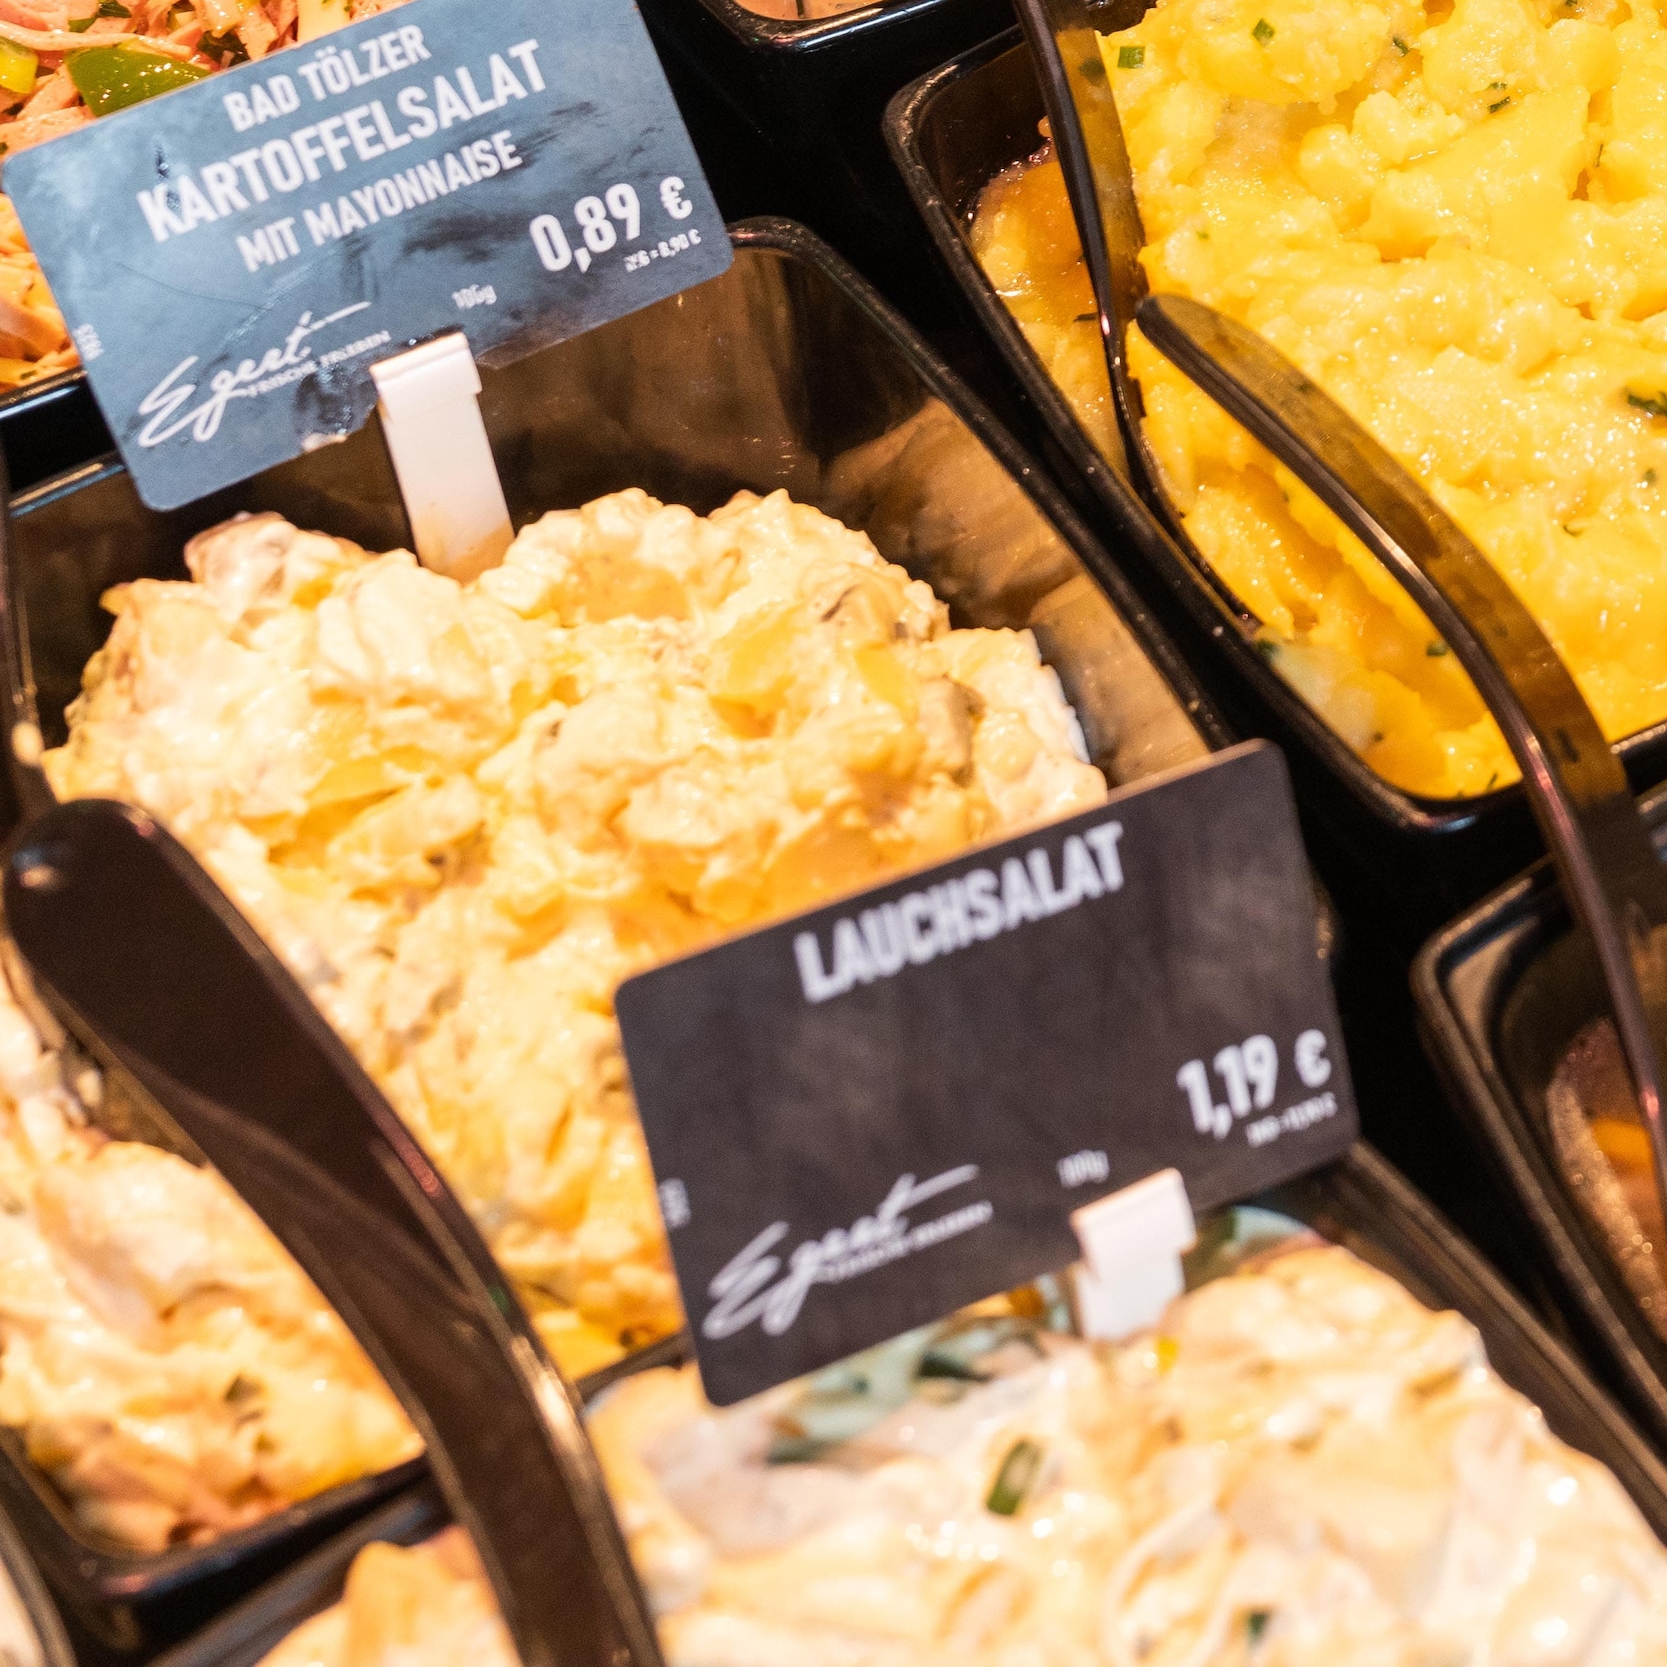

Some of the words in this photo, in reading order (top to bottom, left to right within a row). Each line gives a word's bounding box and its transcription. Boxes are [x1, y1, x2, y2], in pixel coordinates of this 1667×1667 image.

[221, 72, 302, 133] BAD
[299, 18, 432, 102] TÖLZER
[135, 37, 551, 246] KARTOFFELSALAT
[234, 216, 302, 274] MIT
[301, 128, 523, 248] MAYONNAISE
[527, 180, 648, 280] 0,89
[657, 173, 695, 222] €
[795, 822, 1123, 1002] LAUCHSALAT
[1176, 1035, 1279, 1138] 1,19
[1295, 1030, 1332, 1087] €
